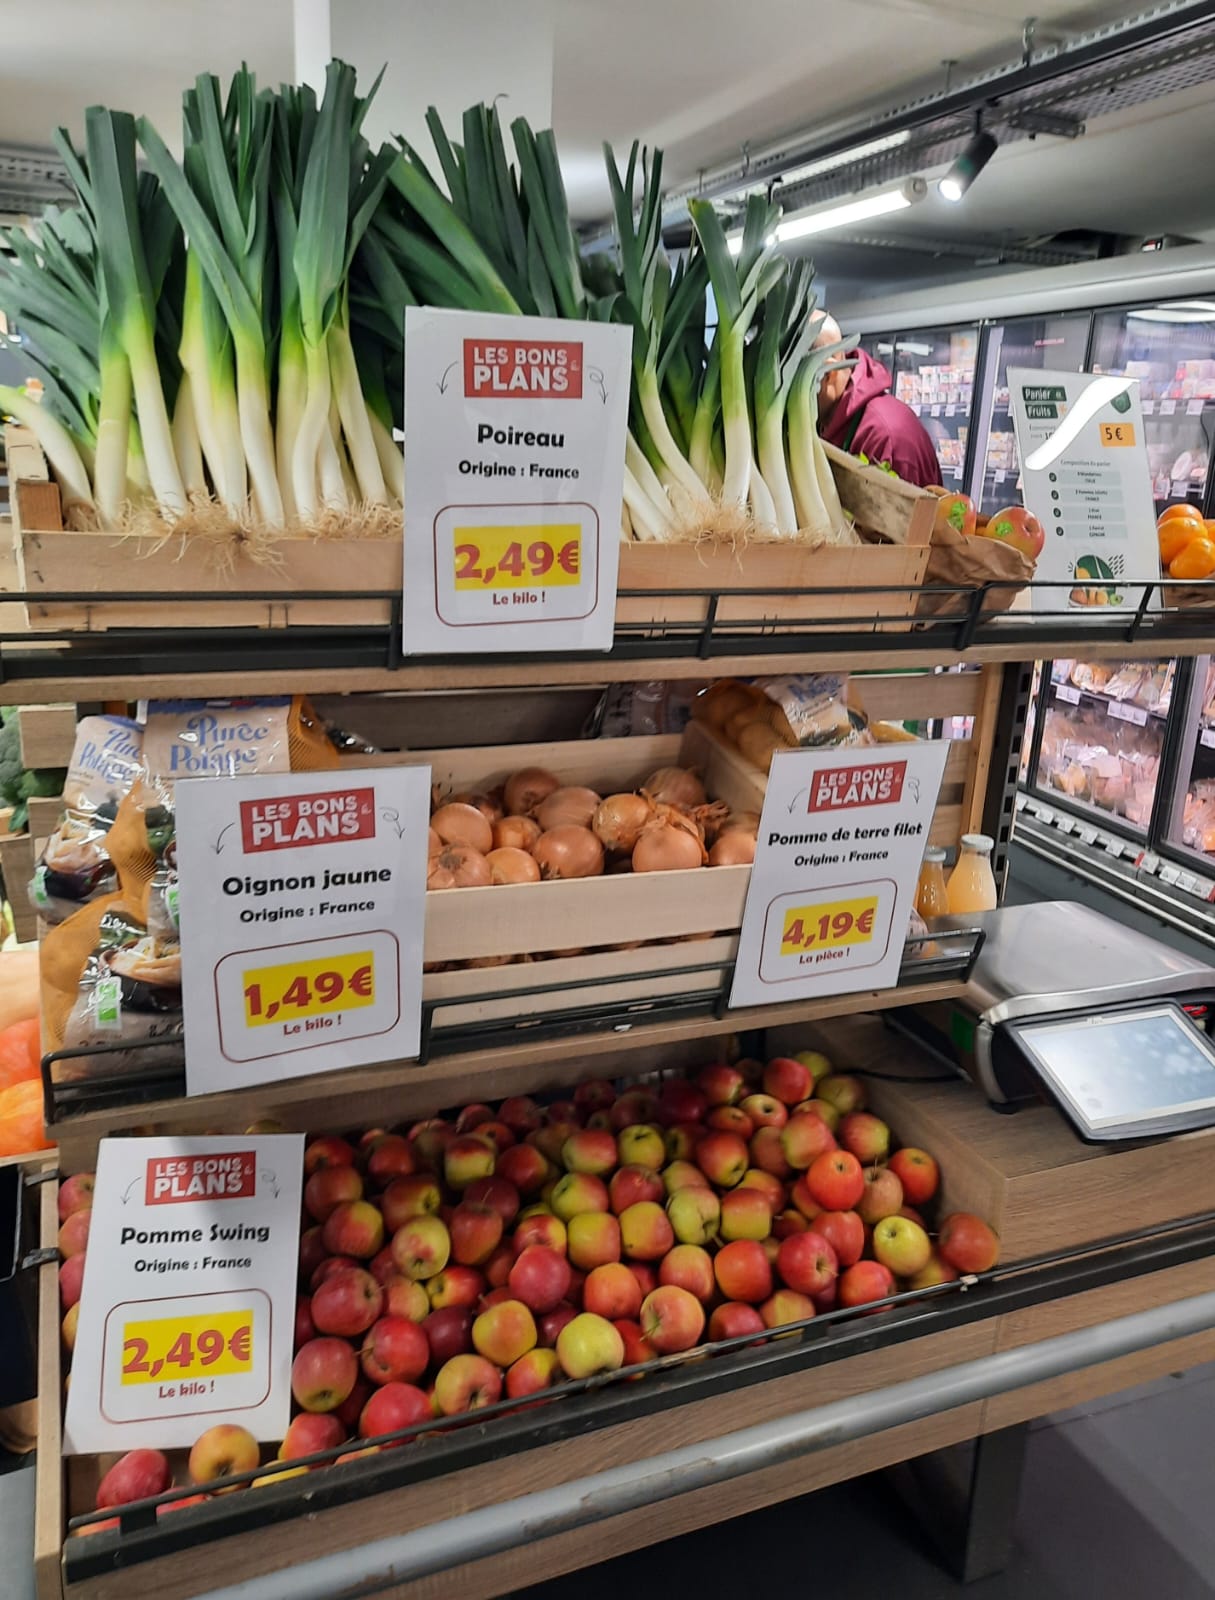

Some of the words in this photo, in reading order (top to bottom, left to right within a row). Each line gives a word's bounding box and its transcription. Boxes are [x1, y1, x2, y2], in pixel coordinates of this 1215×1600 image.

[474, 346, 508, 365] LES
[515, 348, 568, 366] BONS
[474, 366, 568, 392] PLANS
[1025, 388, 1050, 399] Panier
[1028, 406, 1051, 416] Fruits
[477, 423, 565, 448] Poireau
[1106, 428, 1112, 440] 5
[1115, 428, 1123, 440] €
[458, 460, 516, 478] Origine
[529, 464, 579, 479] France
[454, 540, 580, 584] 2,49€
[492, 592, 509, 606] Le
[512, 592, 538, 605] kilo
[187, 714, 269, 746] Purée
[820, 773, 847, 787] LES
[852, 767, 894, 784] BONS
[815, 781, 891, 807] PLANS
[251, 803, 291, 823] LES
[298, 795, 358, 817] BONS
[252, 811, 360, 846] PLANS
[768, 831, 828, 846] Pomme
[832, 828, 850, 842] de
[854, 825, 890, 839] terre
[894, 822, 922, 836] filet
[795, 854, 839, 867] Origine
[848, 850, 888, 862] France
[222, 873, 316, 896] Oignon
[322, 866, 392, 890] jaune
[239, 905, 305, 925] Origine
[319, 899, 375, 916] France
[782, 908, 875, 947] 4,19€
[799, 954, 813, 964] La
[244, 965, 373, 1018] 1,49€
[283, 1021, 301, 1036] Le
[305, 1018, 333, 1032] kilo
[155, 1162, 187, 1177] LES
[193, 1158, 242, 1175] BONS
[154, 1172, 243, 1198] PLANS
[120, 1226, 203, 1245] Pomme
[208, 1223, 270, 1244] Swing
[134, 1258, 190, 1273] Origine
[202, 1255, 252, 1270] France
[123, 1326, 251, 1377] 2,49€
[159, 1385, 176, 1399] Le
[179, 1382, 206, 1397] kilo
